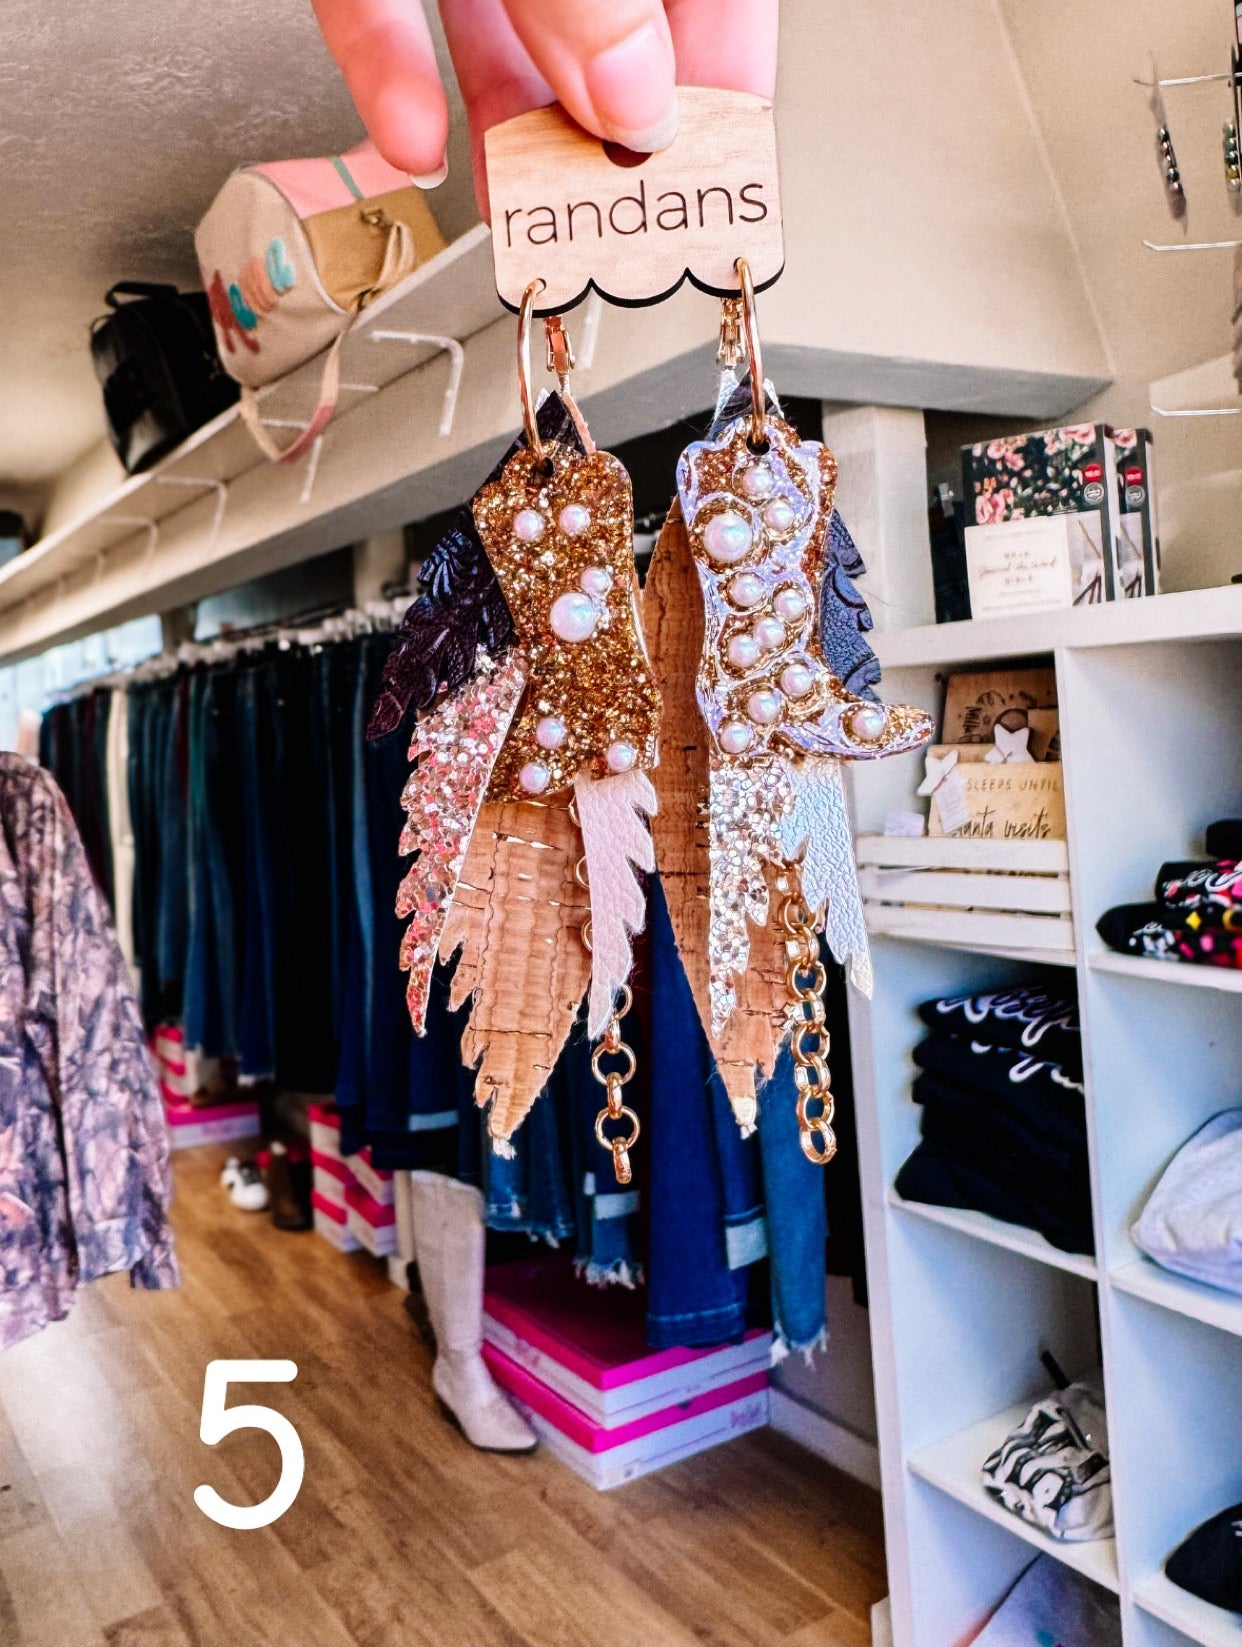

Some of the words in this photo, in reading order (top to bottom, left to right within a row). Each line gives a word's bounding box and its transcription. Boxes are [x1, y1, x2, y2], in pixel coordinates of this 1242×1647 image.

[505, 179, 768, 248] randans
[967, 779, 1012, 791] SLEEPS
[1019, 778, 1058, 792] UNTIL
[951, 805, 995, 838] anta
